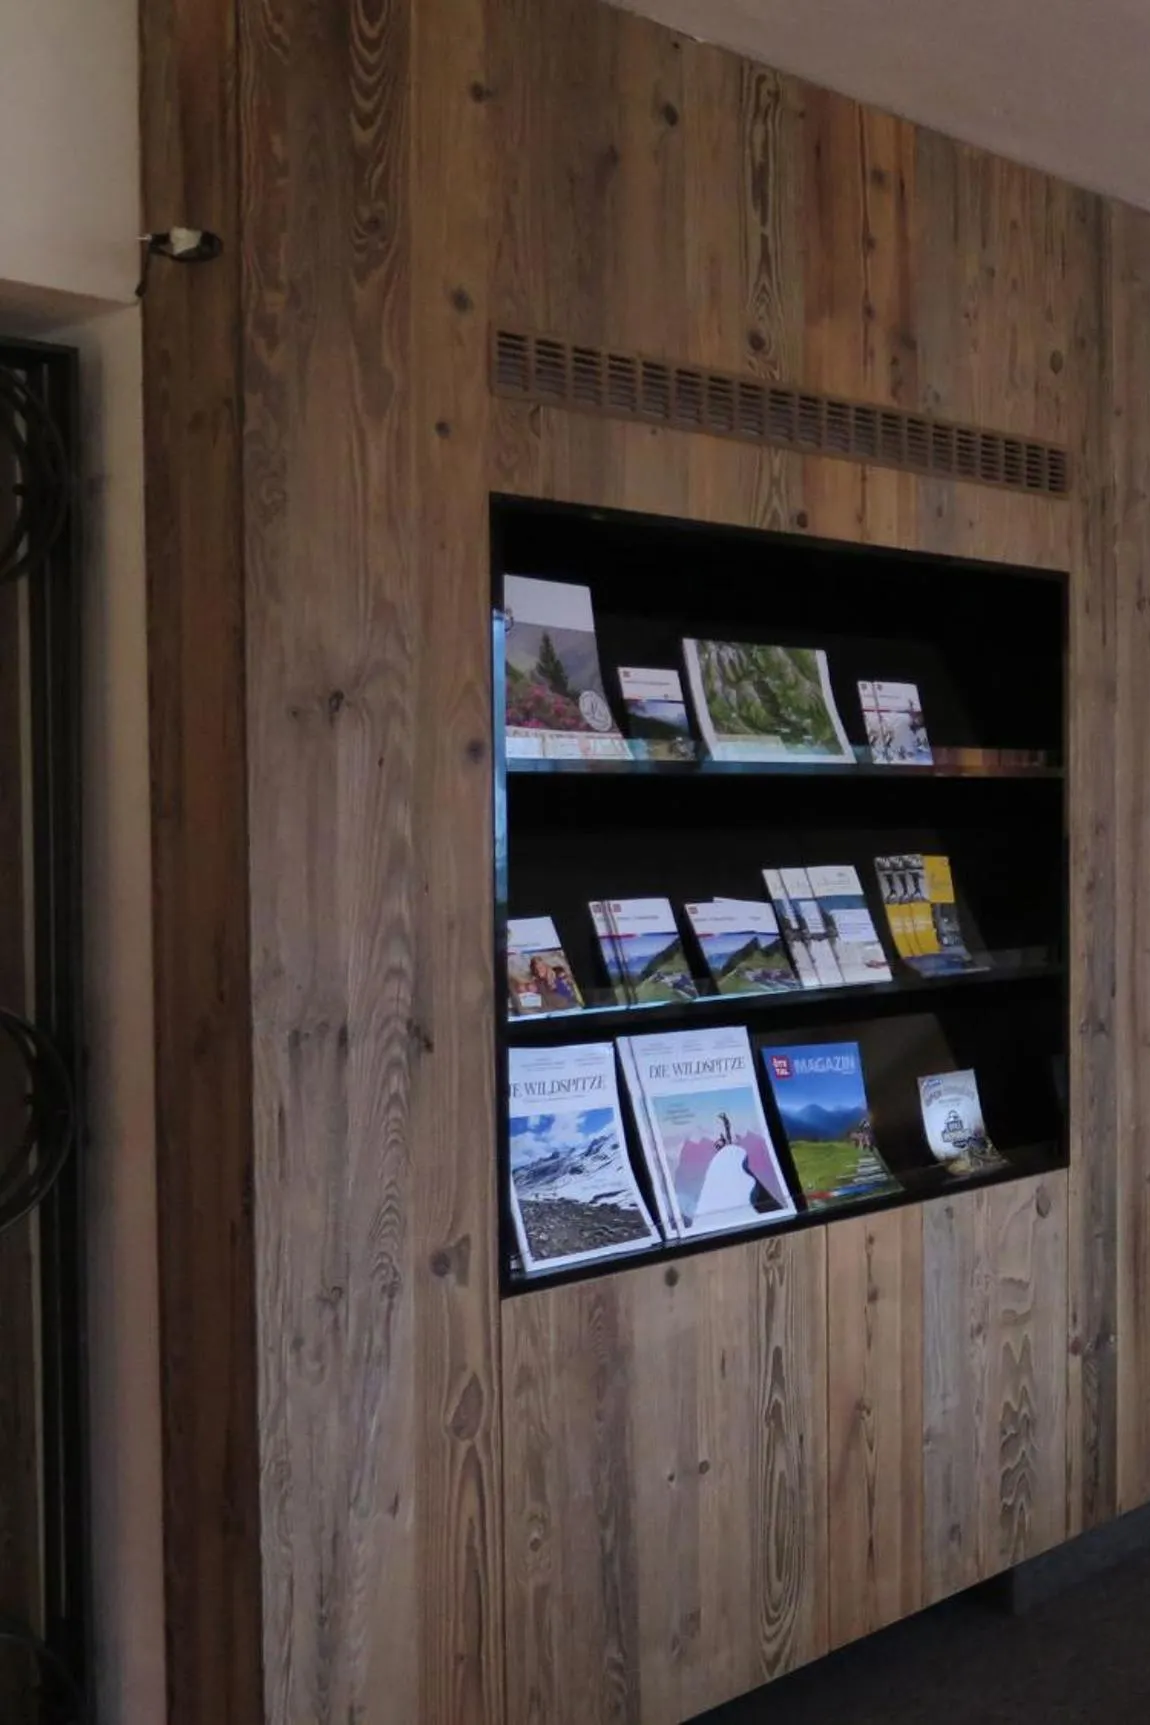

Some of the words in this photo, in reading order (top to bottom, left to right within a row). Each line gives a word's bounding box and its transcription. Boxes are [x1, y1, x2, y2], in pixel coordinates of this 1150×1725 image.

[649, 1064, 670, 1079] DIE
[672, 1057, 746, 1076] WILDSPITZE
[524, 1075, 606, 1096] WILDSPITZE
